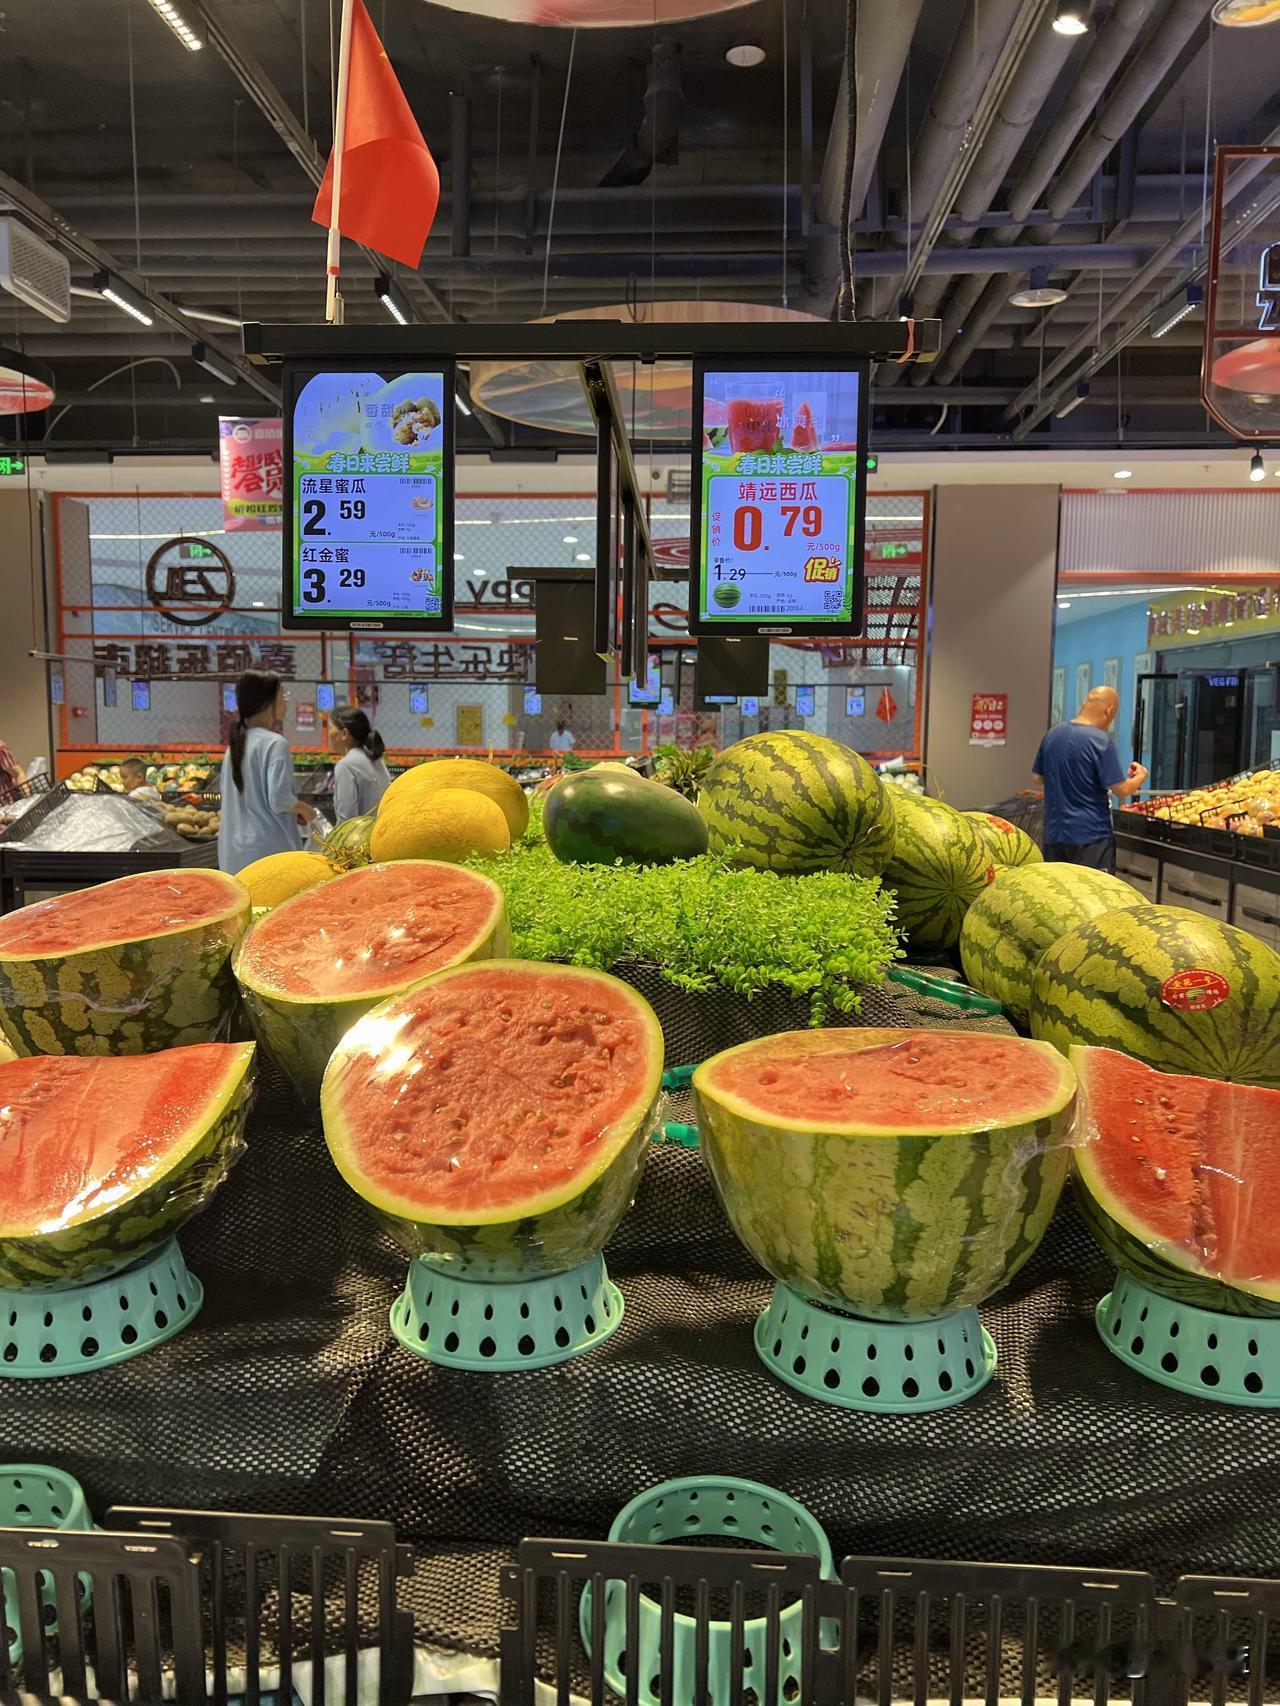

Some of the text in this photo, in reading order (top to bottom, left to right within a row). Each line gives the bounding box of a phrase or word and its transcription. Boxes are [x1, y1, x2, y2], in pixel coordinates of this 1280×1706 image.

[327, 452, 409, 473] 春日来尝鲜
[737, 453, 822, 475] 春日来尝鲜
[302, 478, 366, 494] 流星蜜瓜
[738, 482, 818, 501] 靖远西瓜
[712, 512, 721, 547] 促销价
[302, 547, 349, 563] 红金蜜
[807, 542, 840, 552] 元/500g
[804, 556, 841, 583] 促销
